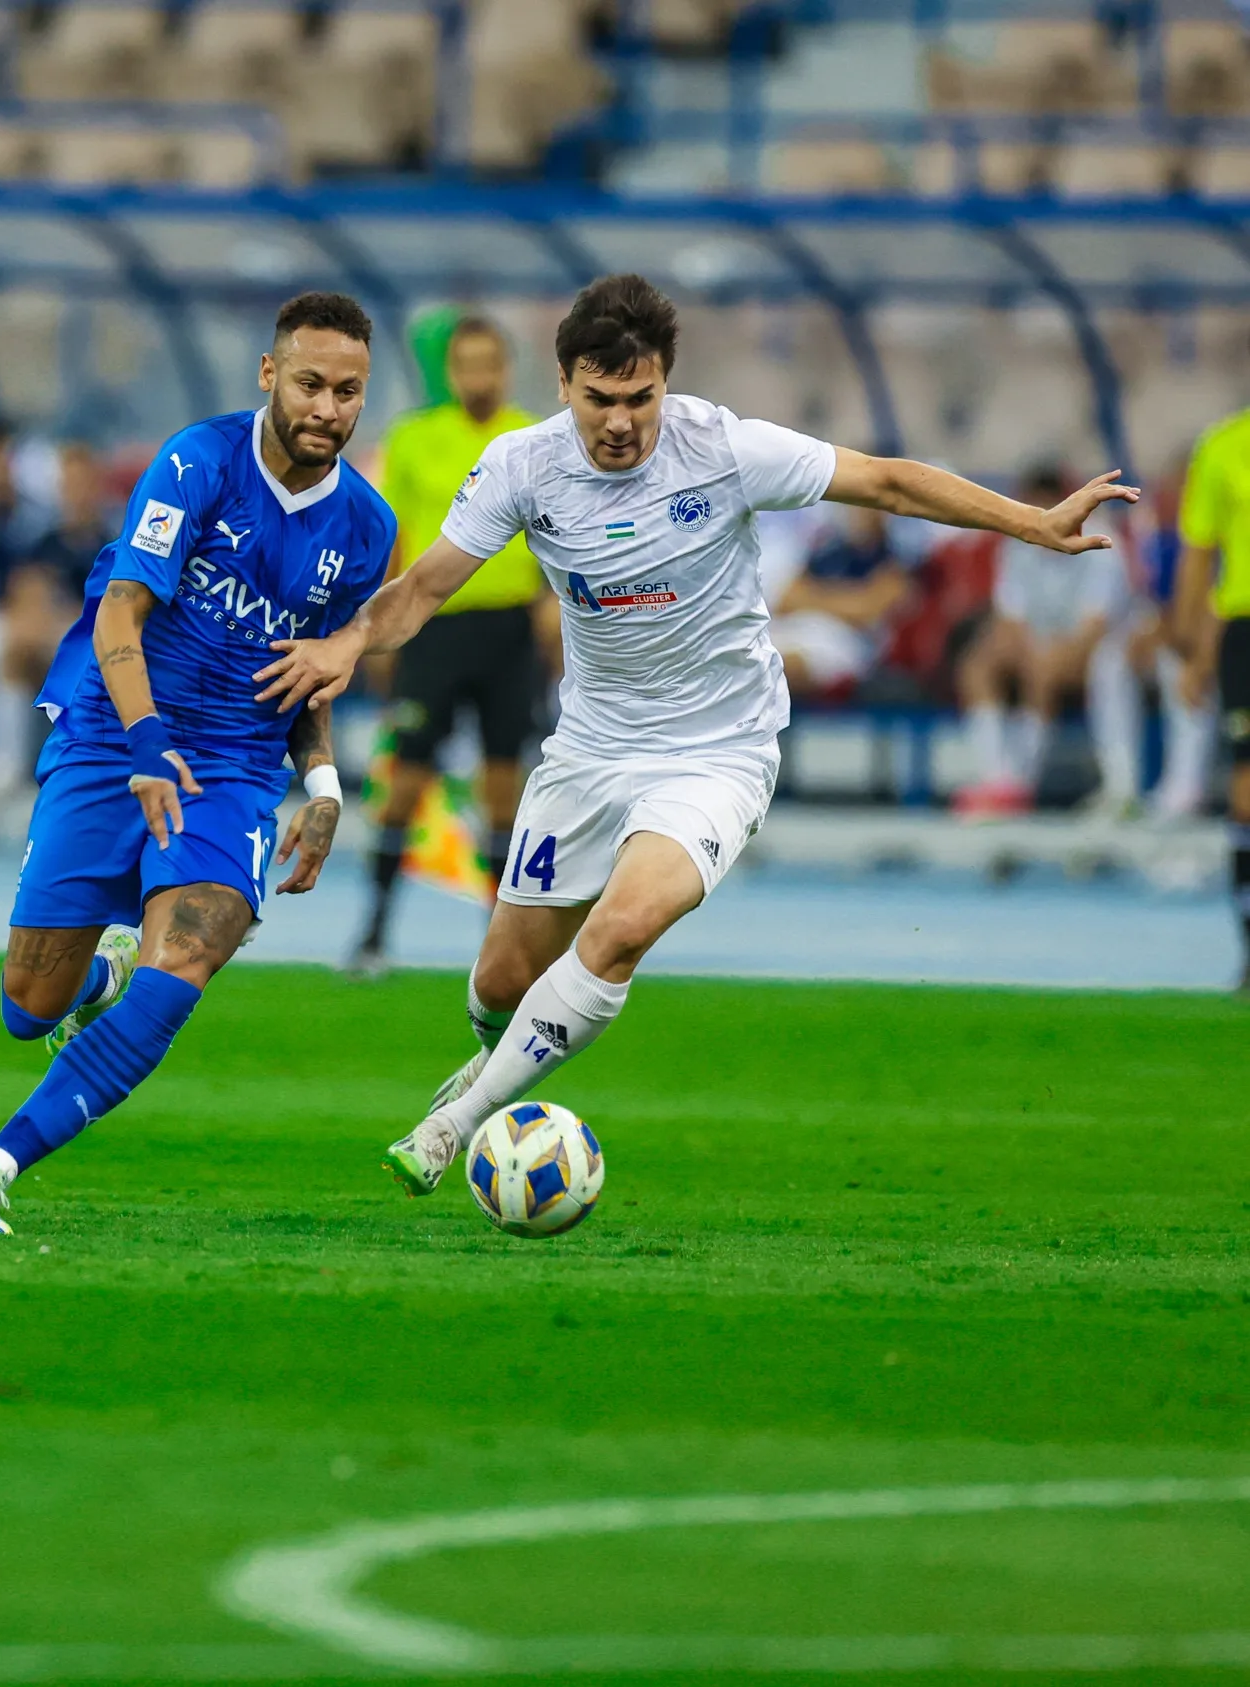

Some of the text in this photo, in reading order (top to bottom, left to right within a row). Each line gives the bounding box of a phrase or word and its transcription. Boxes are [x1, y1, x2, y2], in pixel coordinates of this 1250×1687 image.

[531, 522, 560, 537] adidas
[136, 533, 170, 549] CHAMPIONS
[139, 540, 161, 552] LEAGUE
[181, 556, 310, 640] SAVVY
[601, 582, 670, 597] ART SOFT
[633, 594, 671, 604] CLUSTER
[176, 585, 237, 631] GAMES
[611, 603, 667, 613] HOLDING
[511, 828, 557, 891] 14
[699, 837, 717, 868] adidas
[531, 1017, 570, 1051] adidas
[523, 1035, 551, 1063] 14
